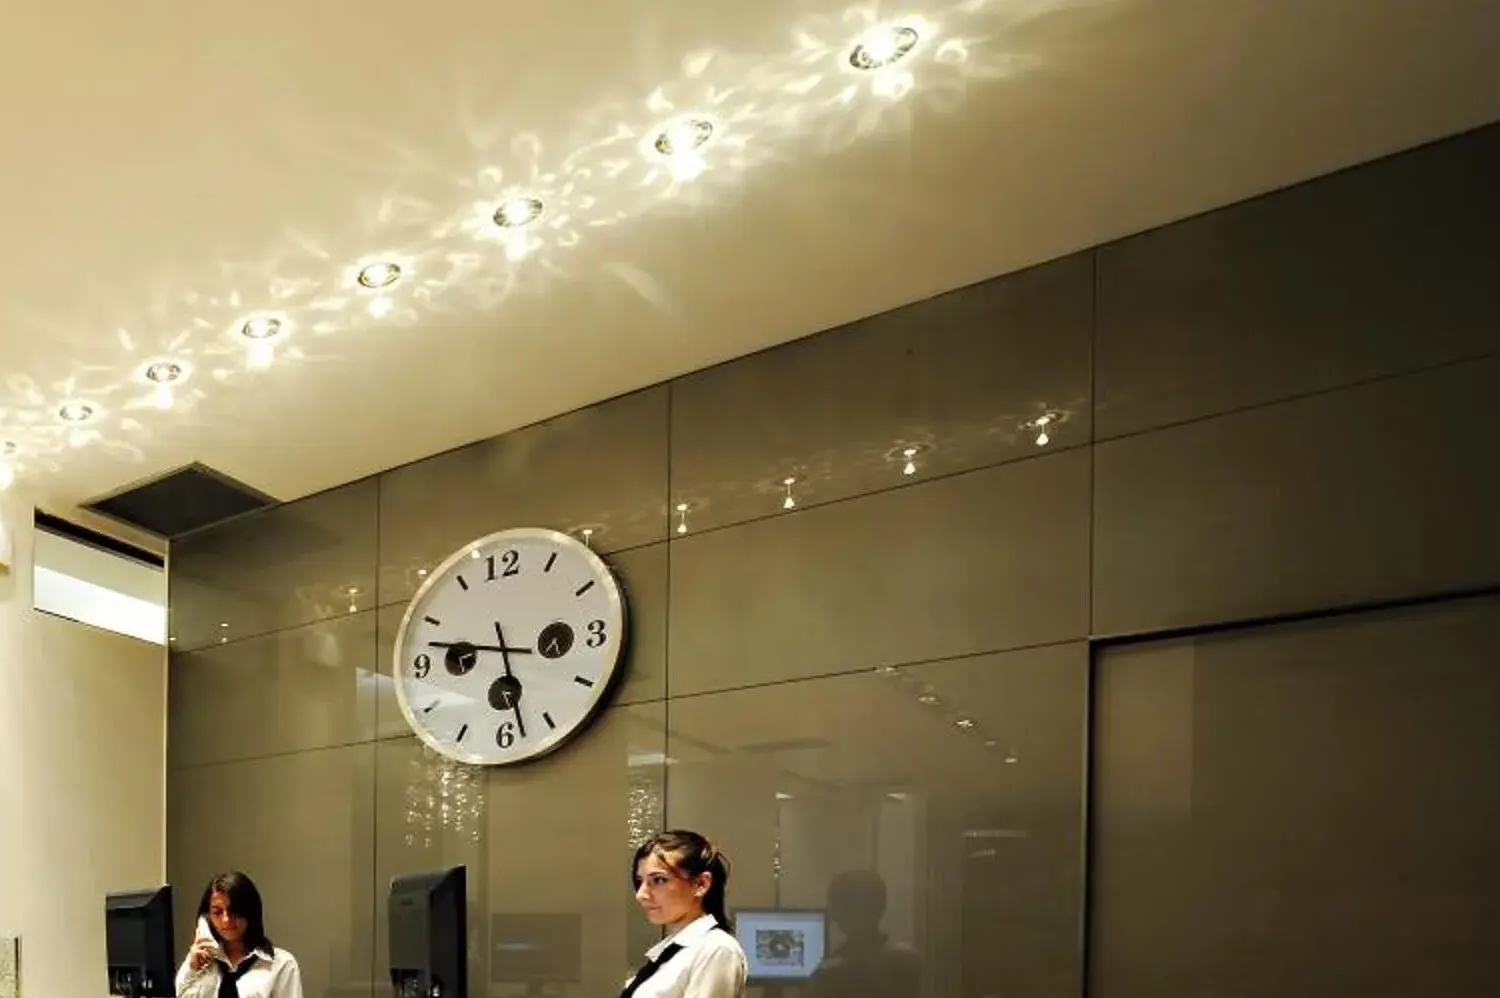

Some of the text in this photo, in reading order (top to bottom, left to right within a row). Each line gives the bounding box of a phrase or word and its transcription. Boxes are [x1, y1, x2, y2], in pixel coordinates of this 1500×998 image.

[484, 550, 519, 581] 12
[586, 620, 606, 648] 3
[414, 654, 430, 678] 9
[496, 722, 514, 748] 6
